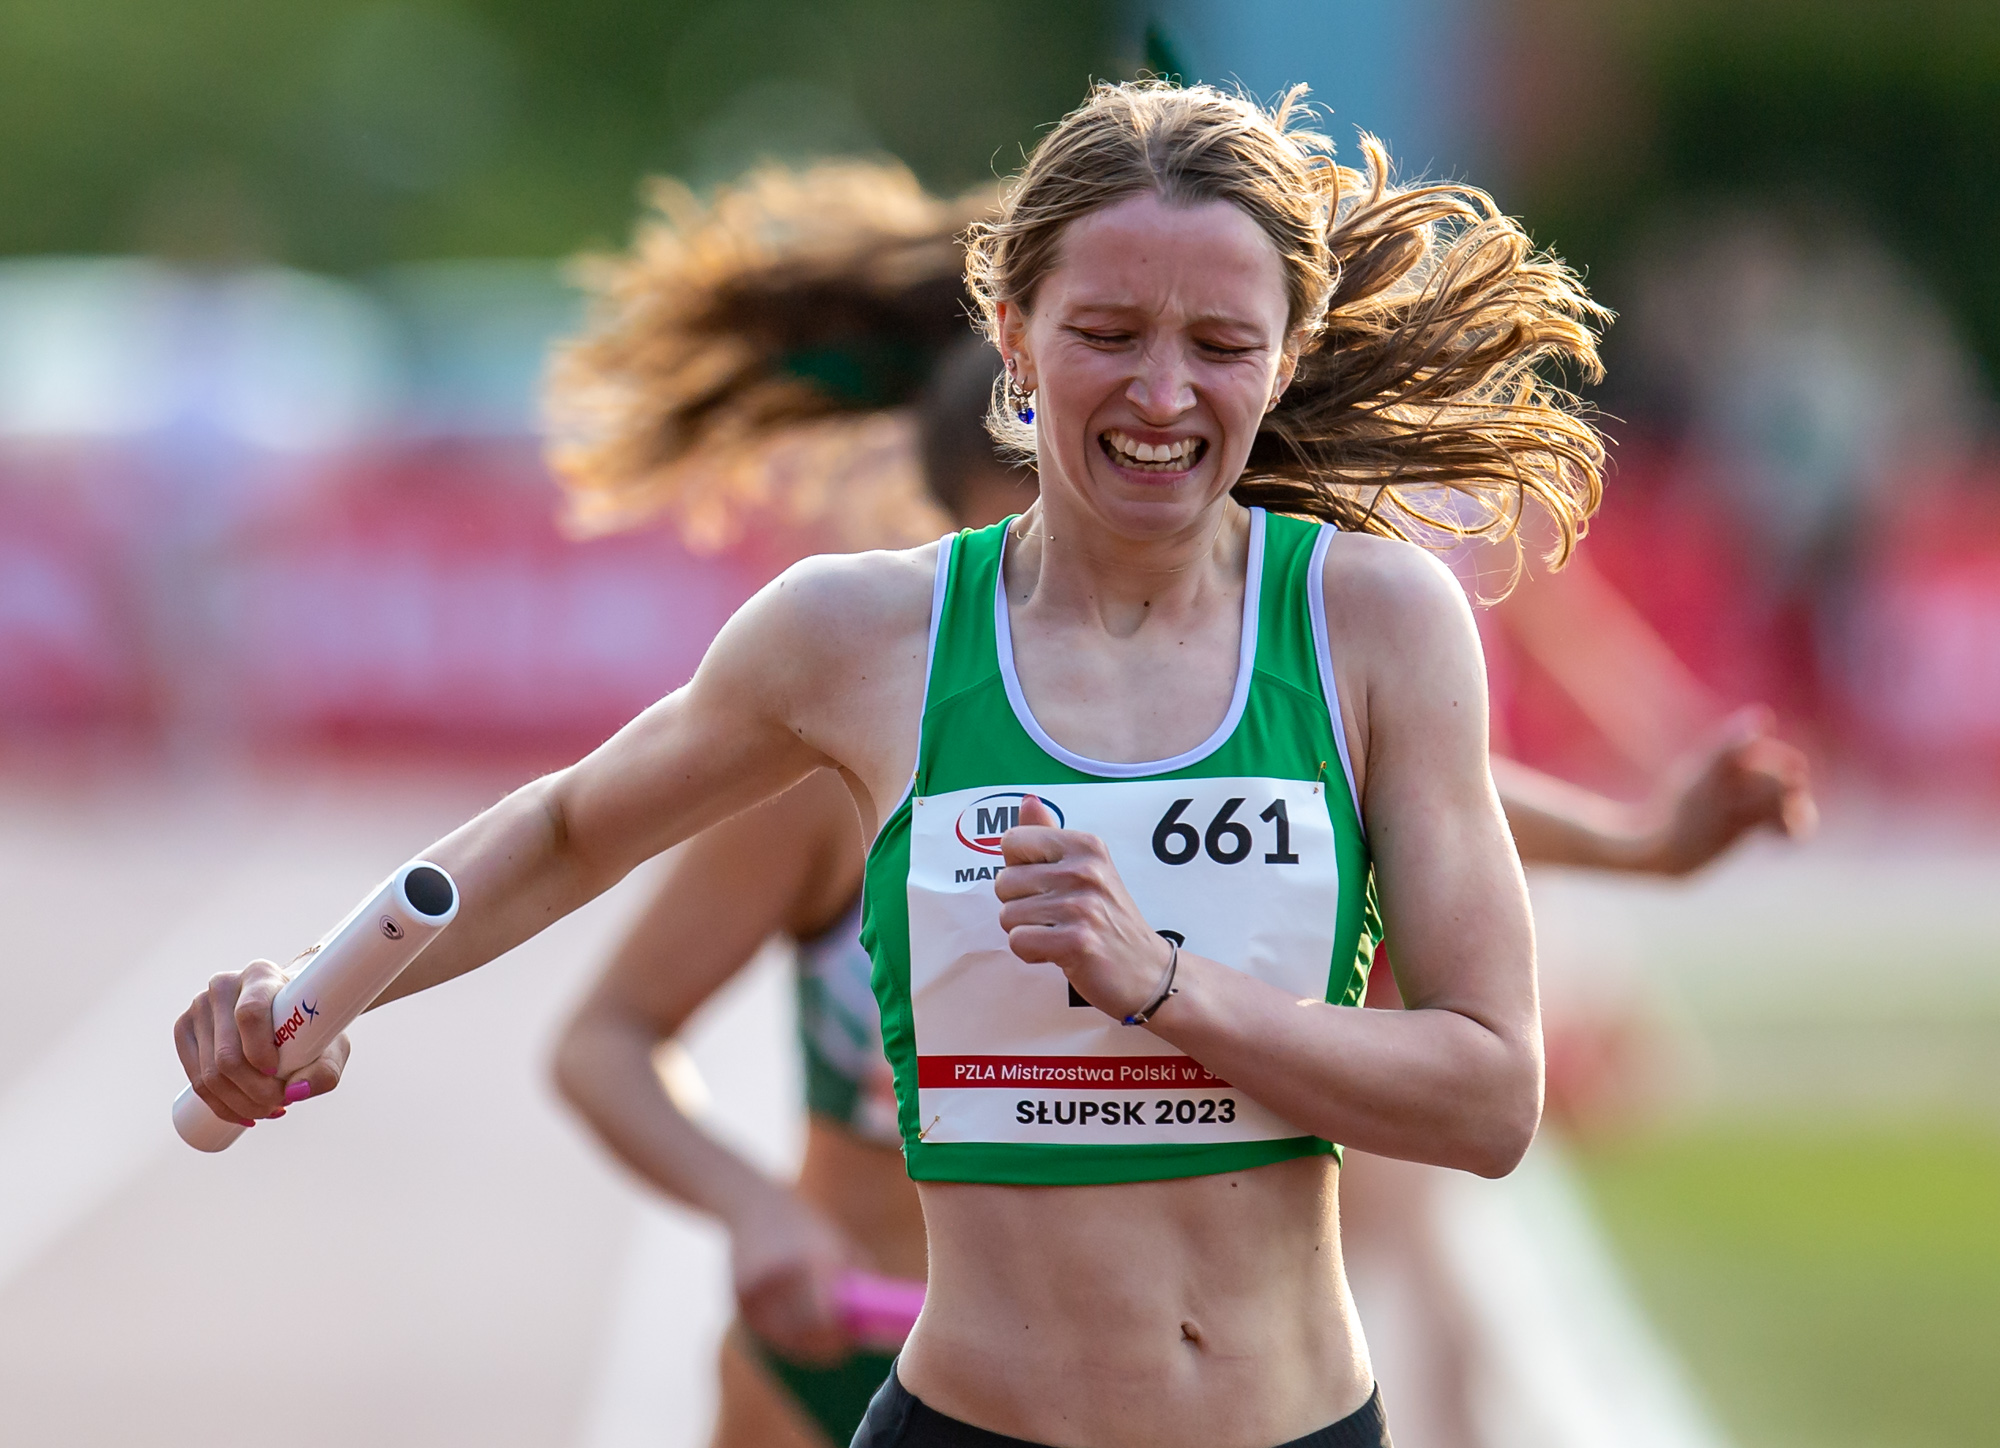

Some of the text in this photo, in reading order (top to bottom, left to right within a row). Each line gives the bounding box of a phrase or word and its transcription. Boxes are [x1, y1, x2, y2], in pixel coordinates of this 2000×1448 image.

[1151, 797, 1300, 866] 661
[954, 1064, 996, 1080] PZLA
[1000, 1063, 1114, 1082] Mistrzostwa
[1120, 1063, 1176, 1081] Polski
[1181, 1067, 1198, 1080] w
[1015, 1098, 1237, 1126] SŁUPSK 2023
